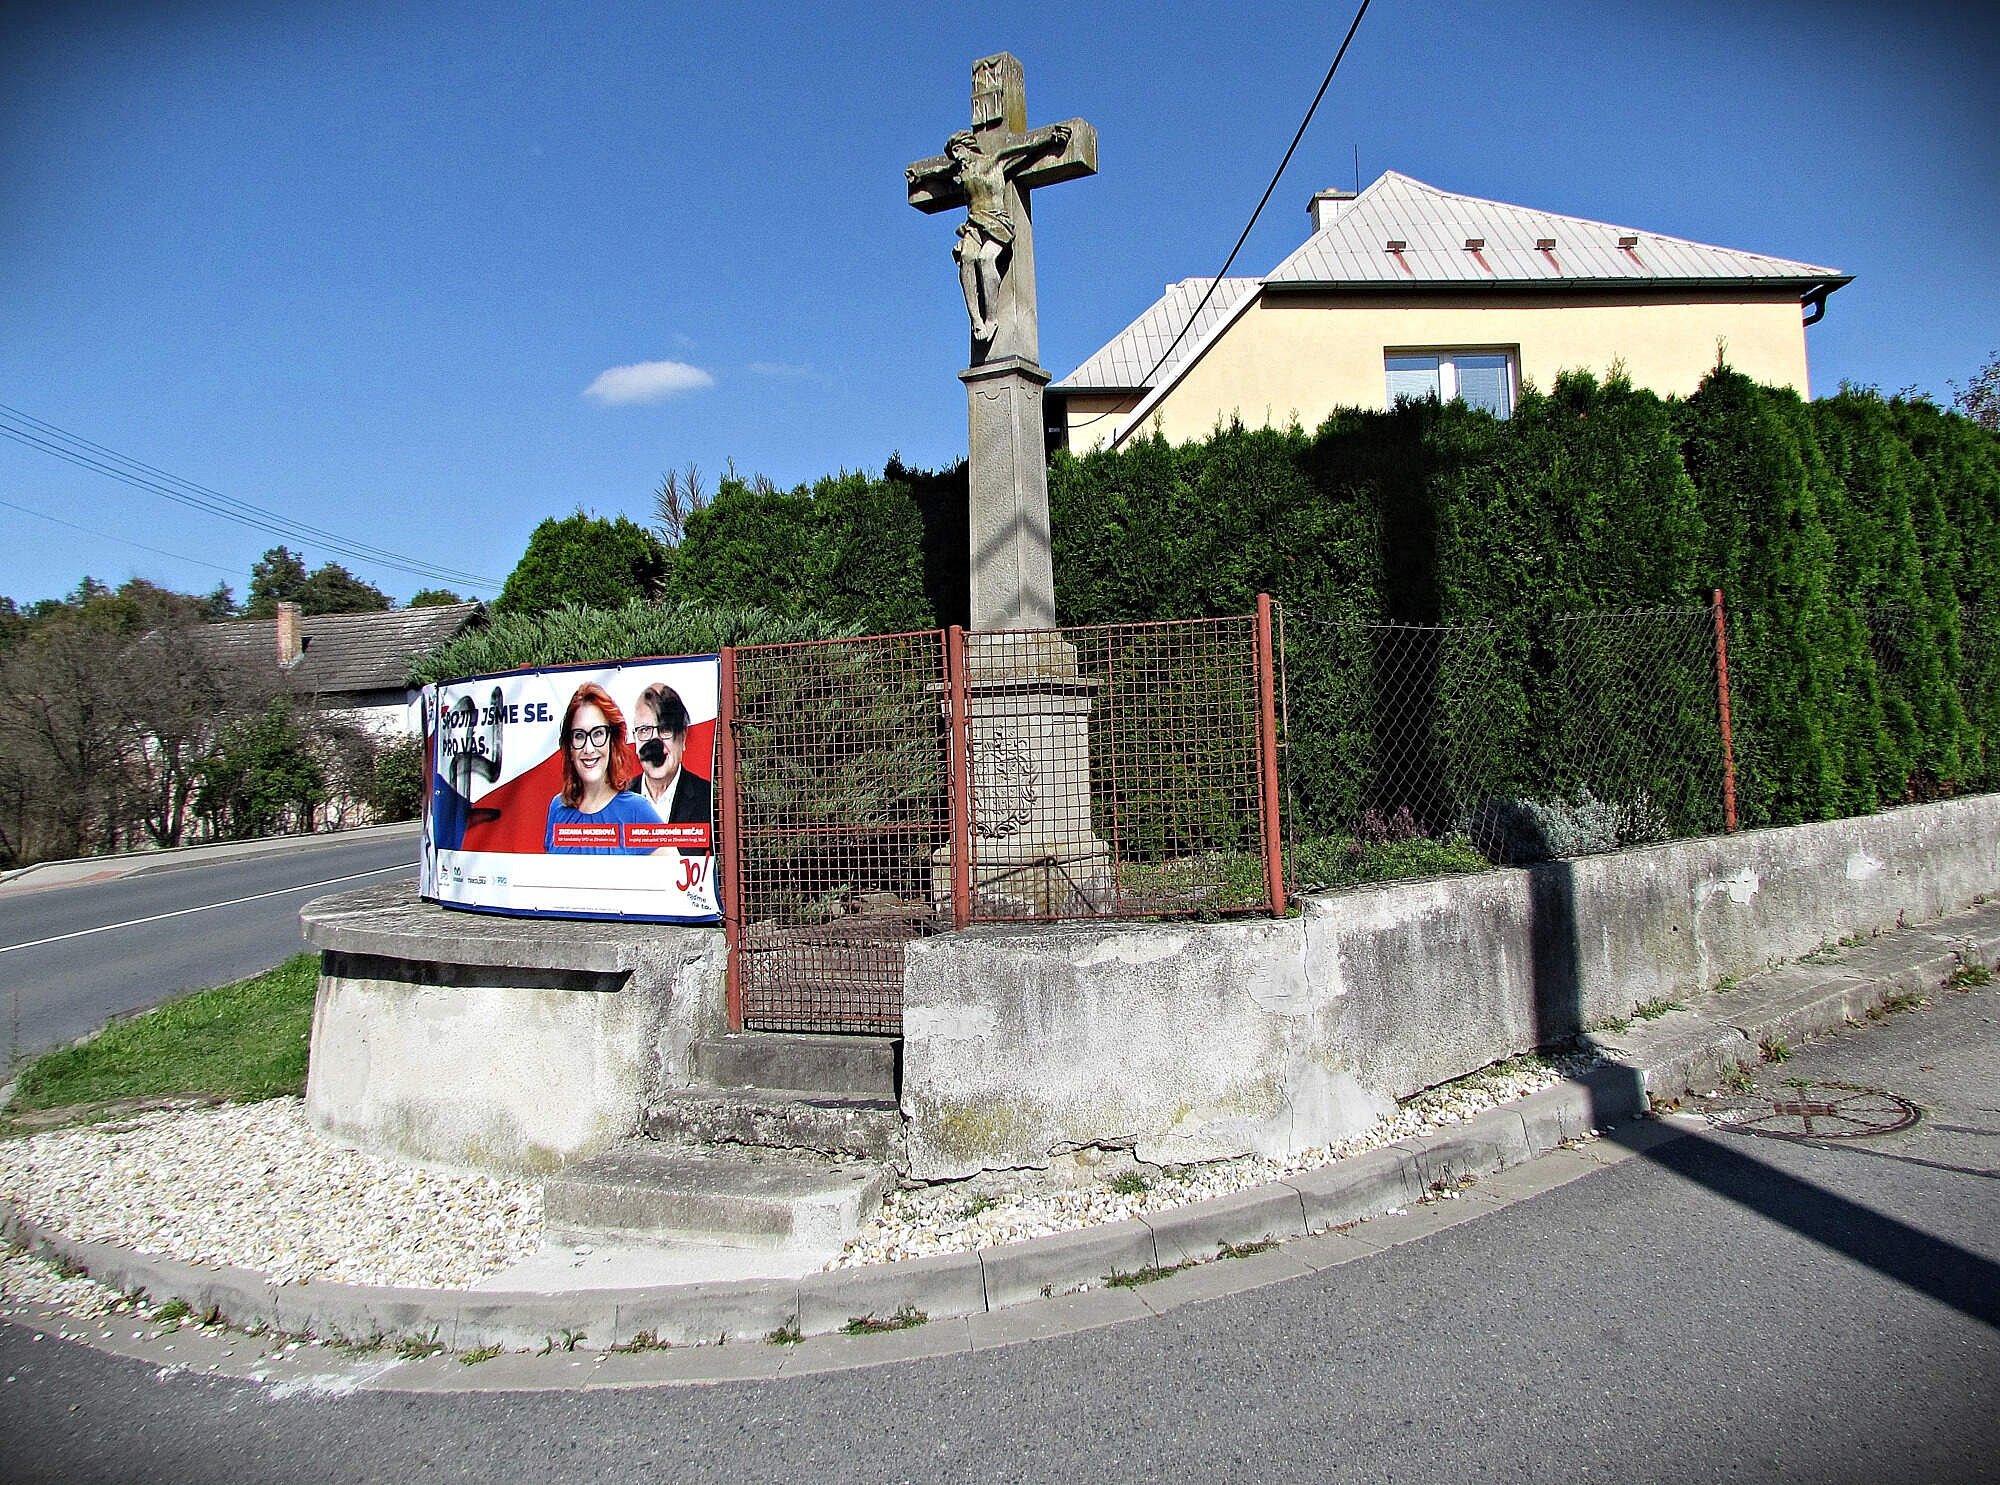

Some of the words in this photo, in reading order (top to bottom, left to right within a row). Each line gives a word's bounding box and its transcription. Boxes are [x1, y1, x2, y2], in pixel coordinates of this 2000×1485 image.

[481, 704, 518, 727] JSME
[524, 702, 554, 723] SE.
[443, 738, 458, 757] PRO
[461, 730, 489, 755] VÁS.
